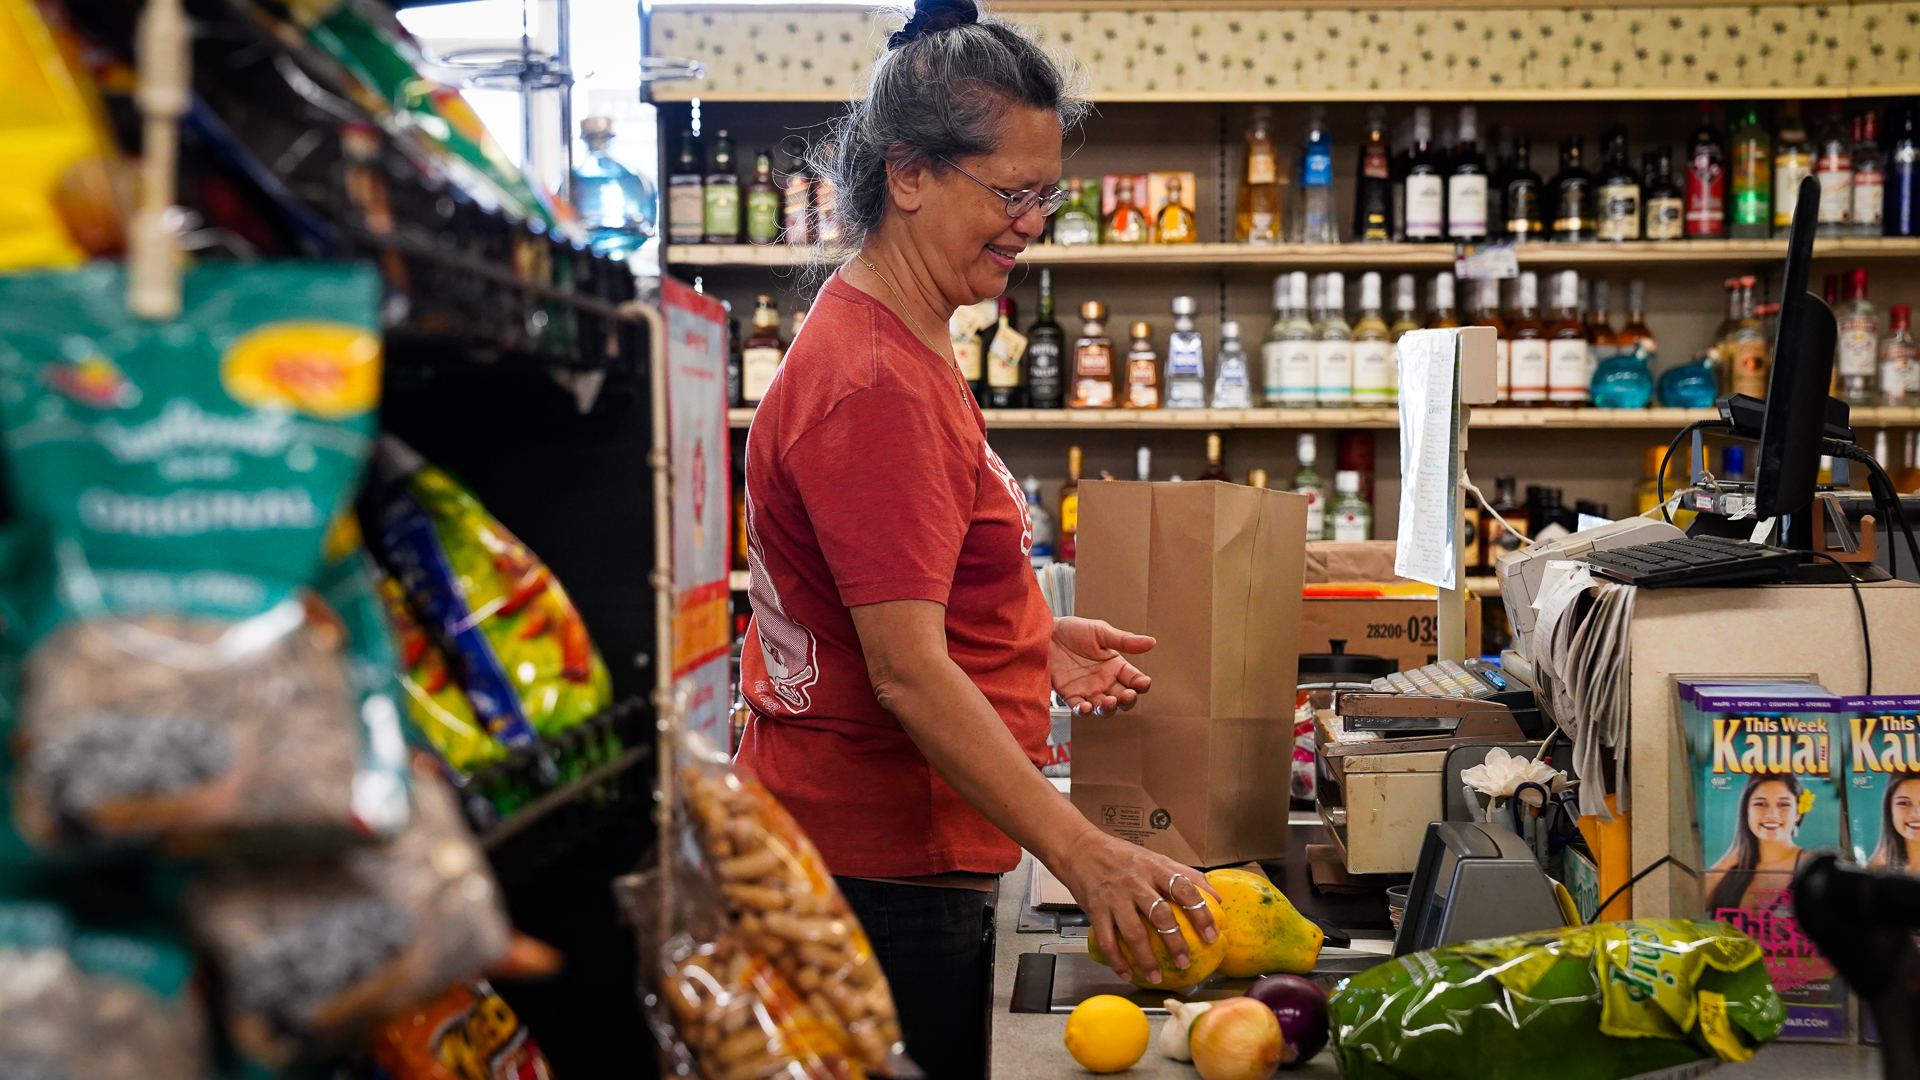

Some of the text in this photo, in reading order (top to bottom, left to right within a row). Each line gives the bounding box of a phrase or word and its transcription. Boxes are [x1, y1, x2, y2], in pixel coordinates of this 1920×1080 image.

[1743, 717, 1829, 733] This Week
[1879, 715, 1916, 732] This
